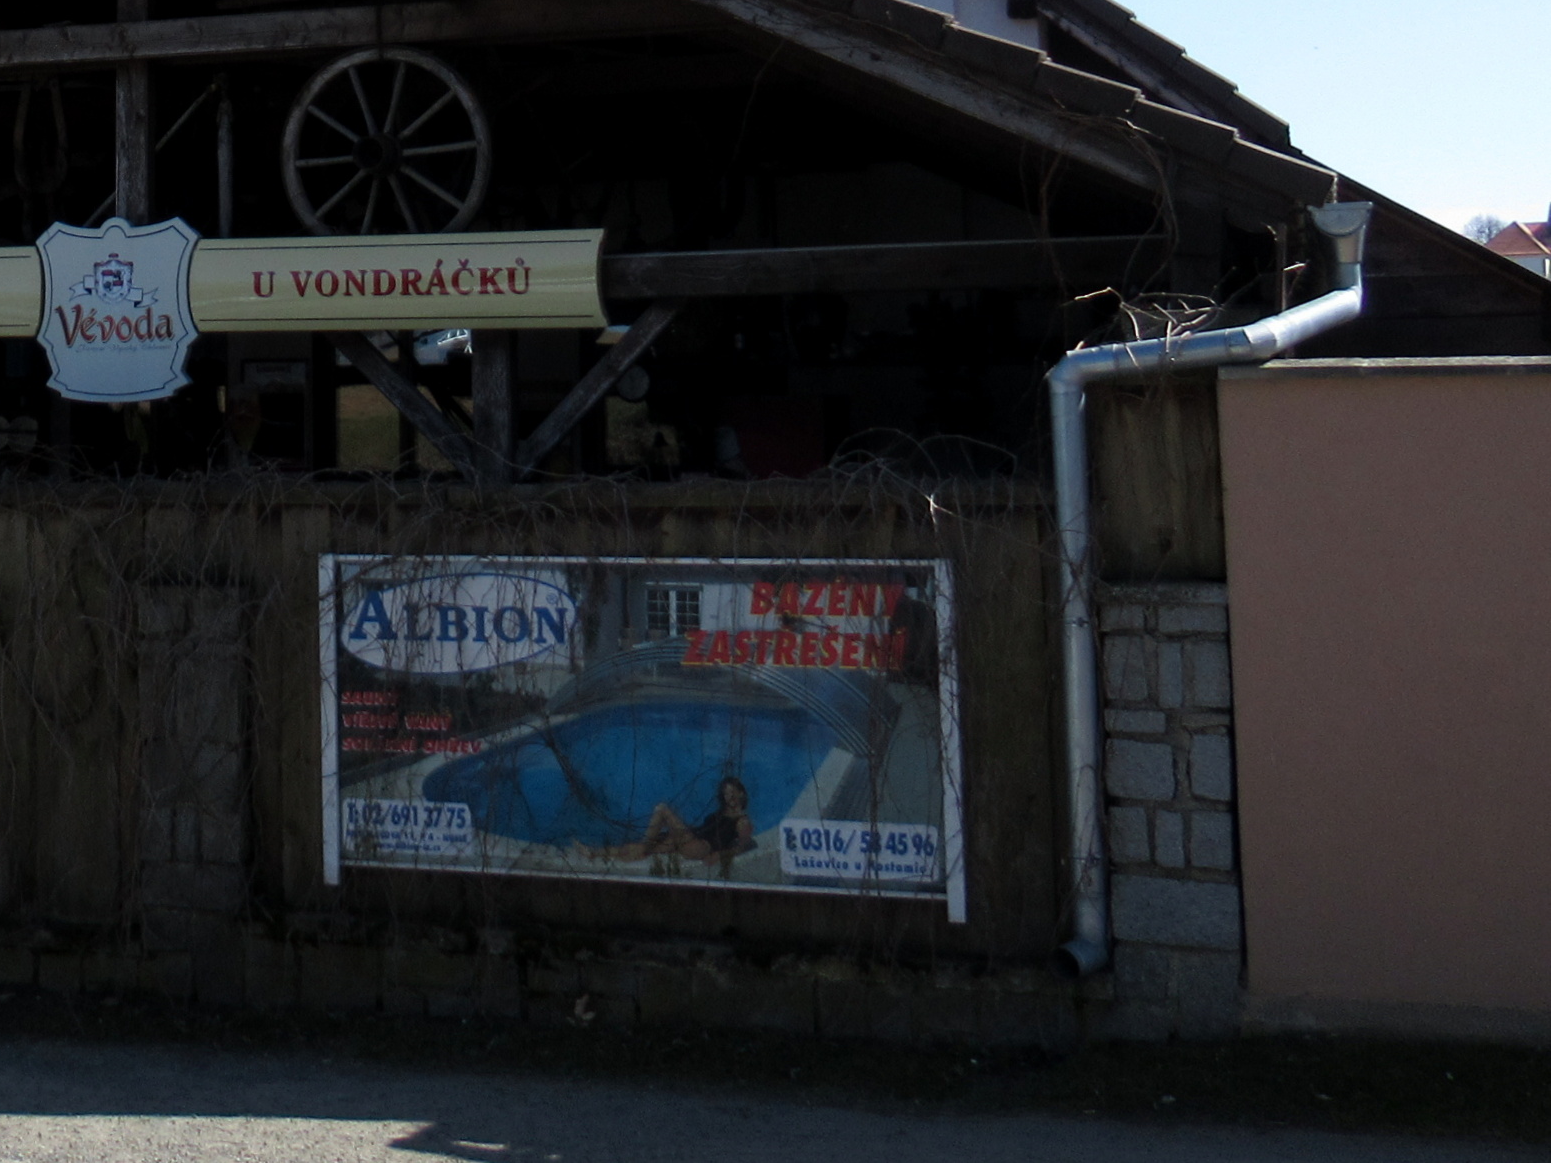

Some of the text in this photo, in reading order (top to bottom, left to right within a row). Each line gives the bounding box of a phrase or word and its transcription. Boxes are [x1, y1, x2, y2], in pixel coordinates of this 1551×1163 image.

[251, 257, 532, 298] U VONDRÁČKŮ
[55, 304, 175, 348] Vévoda
[349, 589, 567, 644] ALBION
[447, 806, 466, 829] 75
[885, 832, 908, 855] 45
[912, 833, 935, 857] 96
